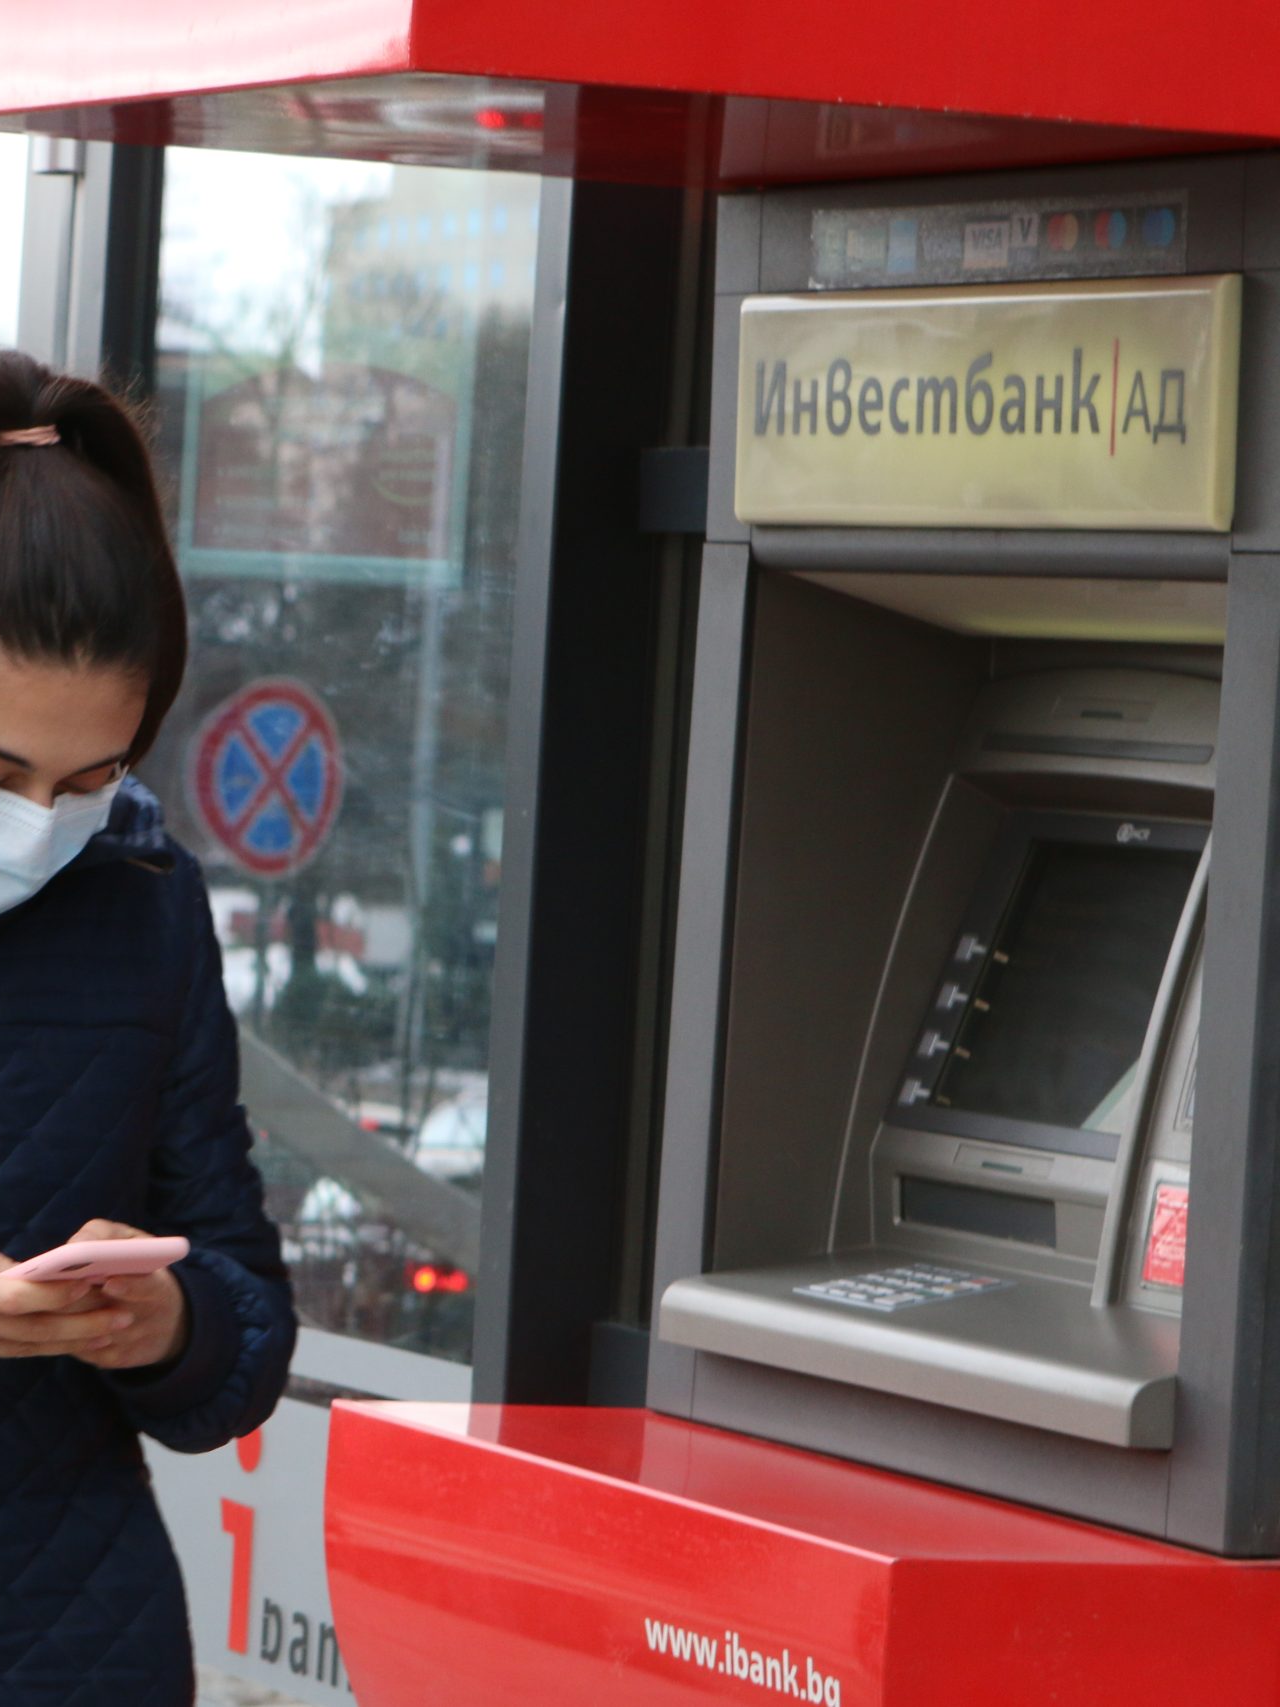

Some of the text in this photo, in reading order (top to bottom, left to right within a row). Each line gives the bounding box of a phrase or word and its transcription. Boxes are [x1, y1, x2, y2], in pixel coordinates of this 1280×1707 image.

[971, 228, 1003, 250] VISA
[1123, 369, 1187, 444] АД
[644, 1617, 840, 1707] www.ibank.bg
